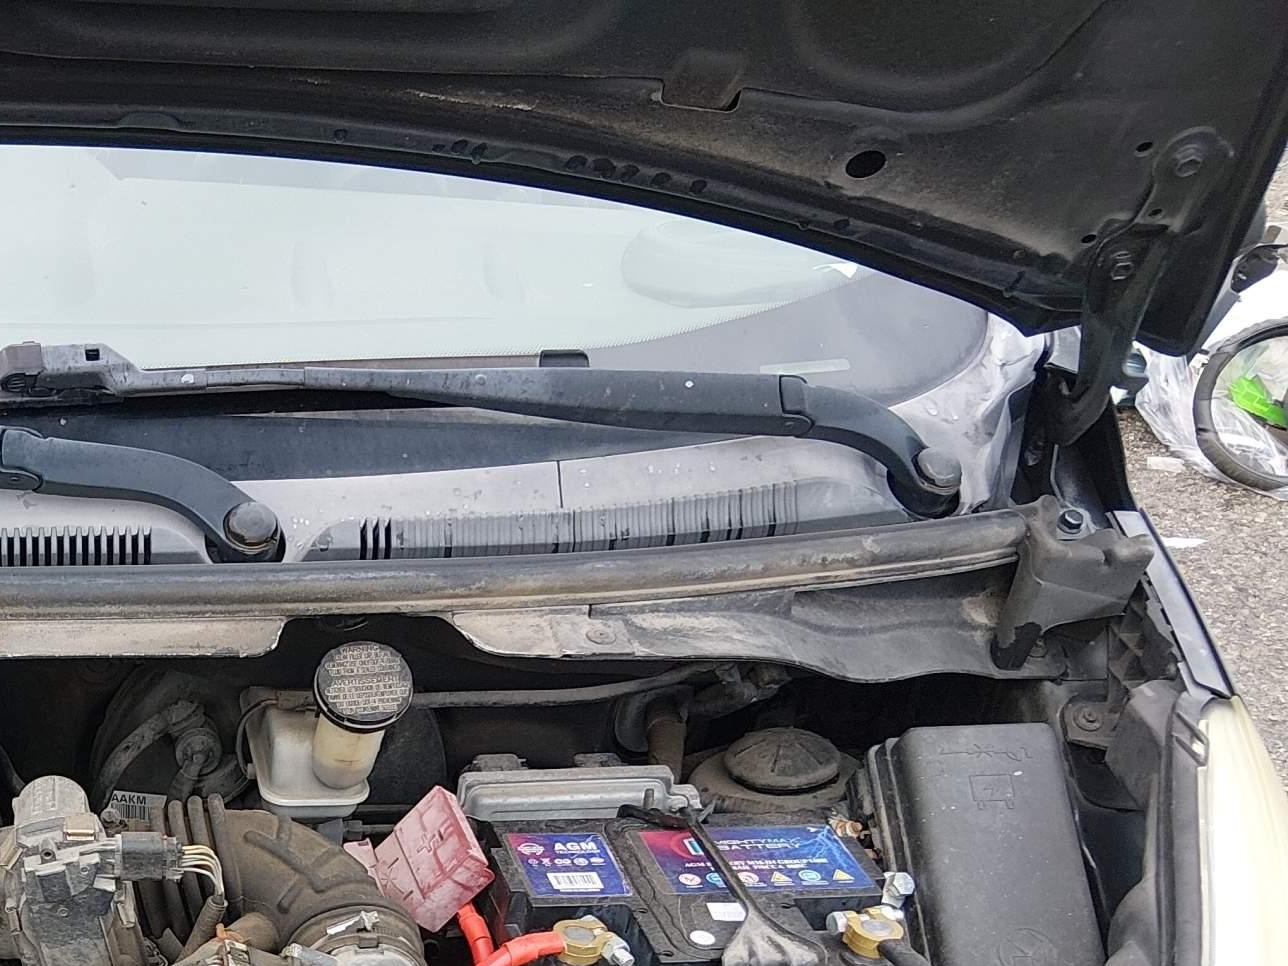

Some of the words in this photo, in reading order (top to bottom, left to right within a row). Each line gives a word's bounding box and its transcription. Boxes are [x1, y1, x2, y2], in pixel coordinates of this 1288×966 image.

[112, 793, 147, 805] AAKM
[554, 842, 598, 851] AGM
[717, 842, 801, 850] BATTERY
